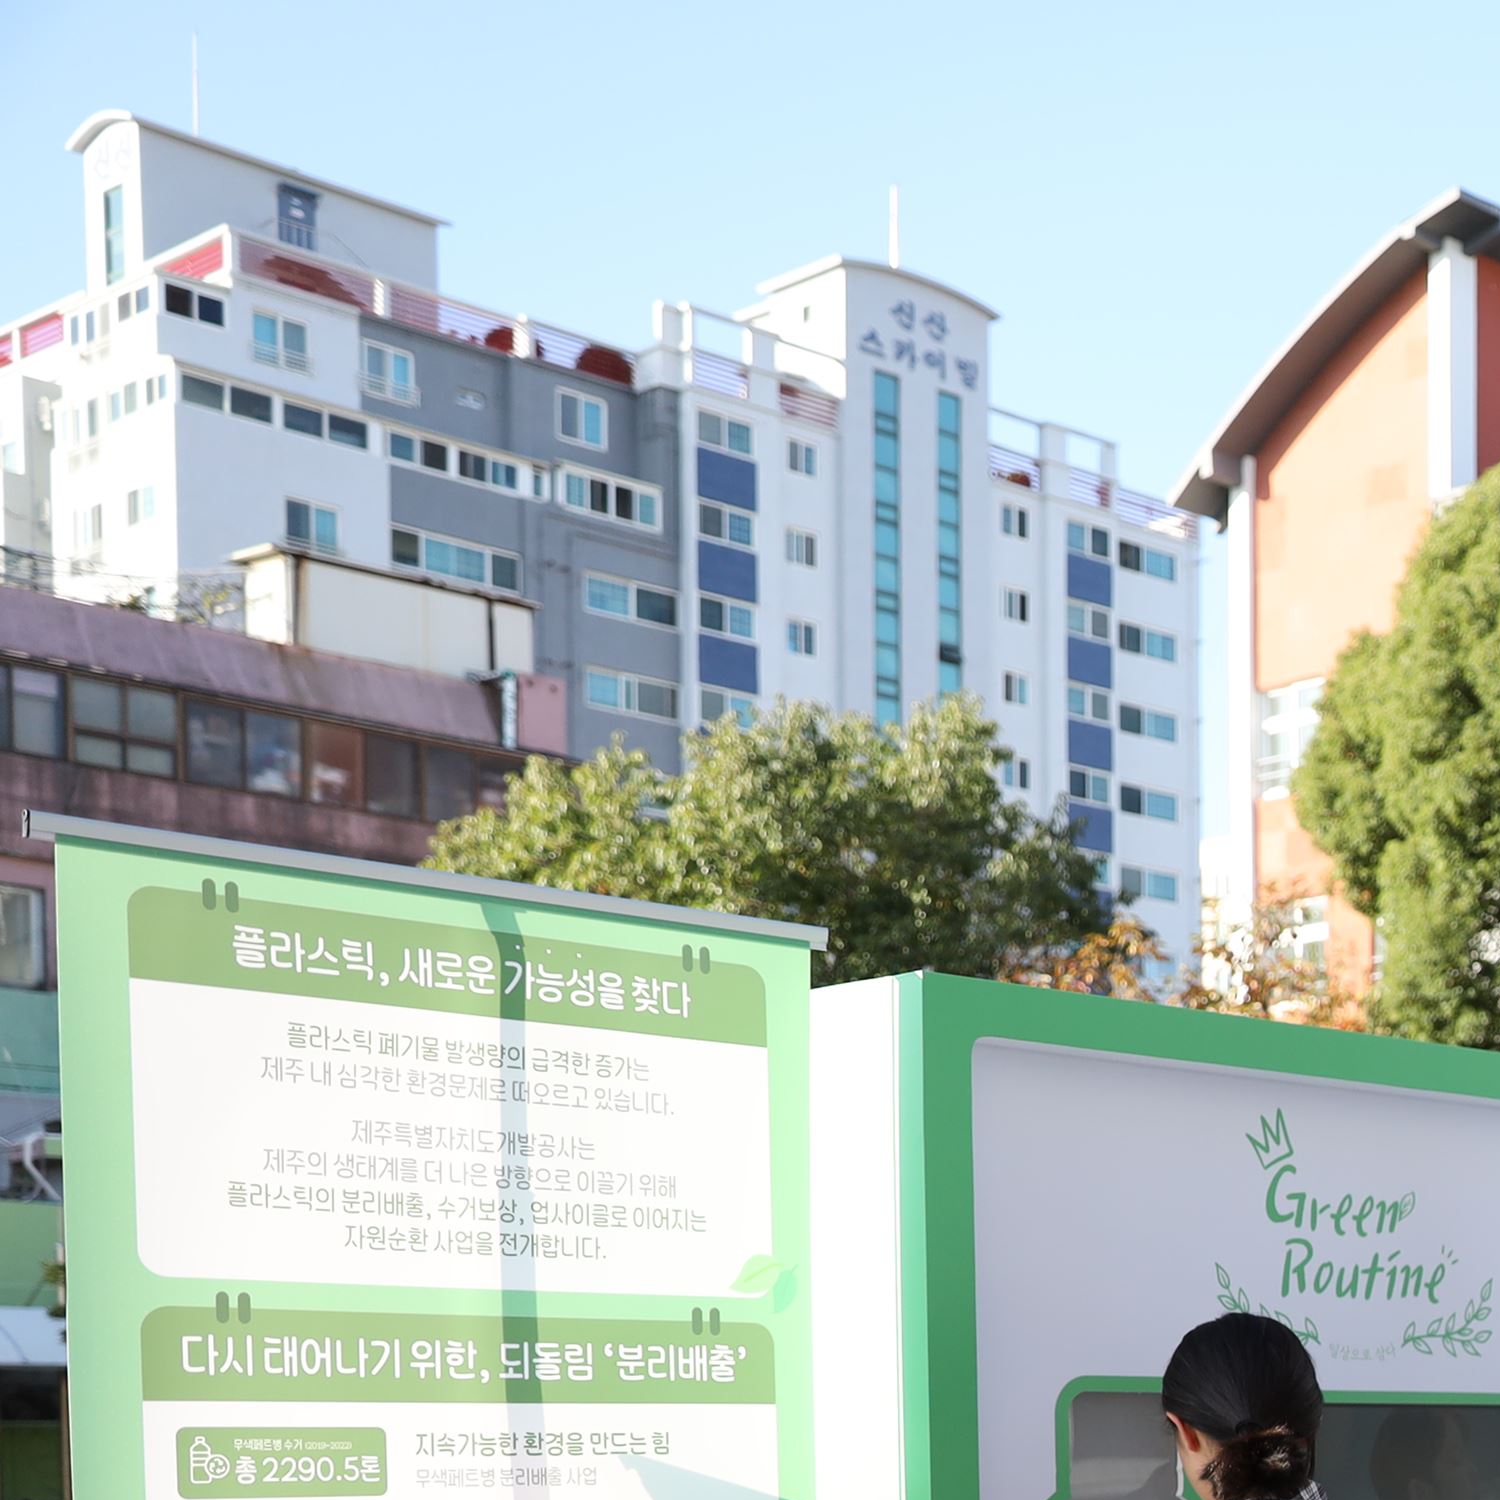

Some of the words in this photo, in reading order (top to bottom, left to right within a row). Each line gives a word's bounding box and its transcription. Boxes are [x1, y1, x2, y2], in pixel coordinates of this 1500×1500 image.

[232, 924, 390, 987] 플라스틱,
[398, 947, 497, 995] 새로운
[504, 960, 625, 1011] 가능성을
[631, 975, 692, 1019] 찾다
[287, 1021, 372, 1055] 플라스틱
[378, 1032, 440, 1062] 폐기물
[445, 1039, 526, 1071] 발생량의
[531, 1048, 591, 1077] 급격한
[595, 1054, 650, 1082] 증가는
[260, 1056, 305, 1084] 제주
[310, 1061, 332, 1087] 내
[337, 1064, 401, 1093] 심각한
[406, 1069, 507, 1102] 환경문제로
[511, 1080, 590, 1109] 떠오르고
[594, 1087, 675, 1117] 있습니다.
[351, 1119, 596, 1161] 제주특별자치도개발공사는
[263, 1148, 327, 1177] 제주의
[333, 1153, 419, 1184] 생태계를
[424, 1160, 443, 1185] 더
[449, 1161, 488, 1188] 나은
[493, 1165, 573, 1192] 방향으로
[577, 1170, 634, 1197] 이끌기
[638, 1174, 677, 1199] 위해
[227, 1181, 335, 1213] 플라스틱의
[342, 1189, 432, 1221] 분리배출,
[437, 1195, 525, 1226] 수거보상,
[531, 1201, 629, 1229] 업사이클로
[633, 1207, 707, 1232] 이어지는
[1265, 1163, 1403, 1239] Green
[344, 1225, 428, 1253] 자원순환
[434, 1230, 494, 1256] 사업을
[499, 1232, 607, 1260] 전개합니다.
[1280, 1238, 1449, 1304] Routine
[181, 1333, 254, 1377] 다시
[263, 1335, 402, 1379] 태어나기
[409, 1339, 490, 1384] 위한,
[498, 1341, 594, 1382] 되돌림
[415, 1432, 519, 1456] 지속가능한
[523, 1431, 585, 1456] 환경을
[590, 1431, 648, 1455] 만드는
[651, 1432, 671, 1455] 힘
[234, 1456, 258, 1484] 총
[262, 1455, 381, 1483] 2290.5톤
[415, 1468, 495, 1488] 무색페트병
[500, 1467, 563, 1487] 분리배출
[566, 1467, 598, 1486] 사업
